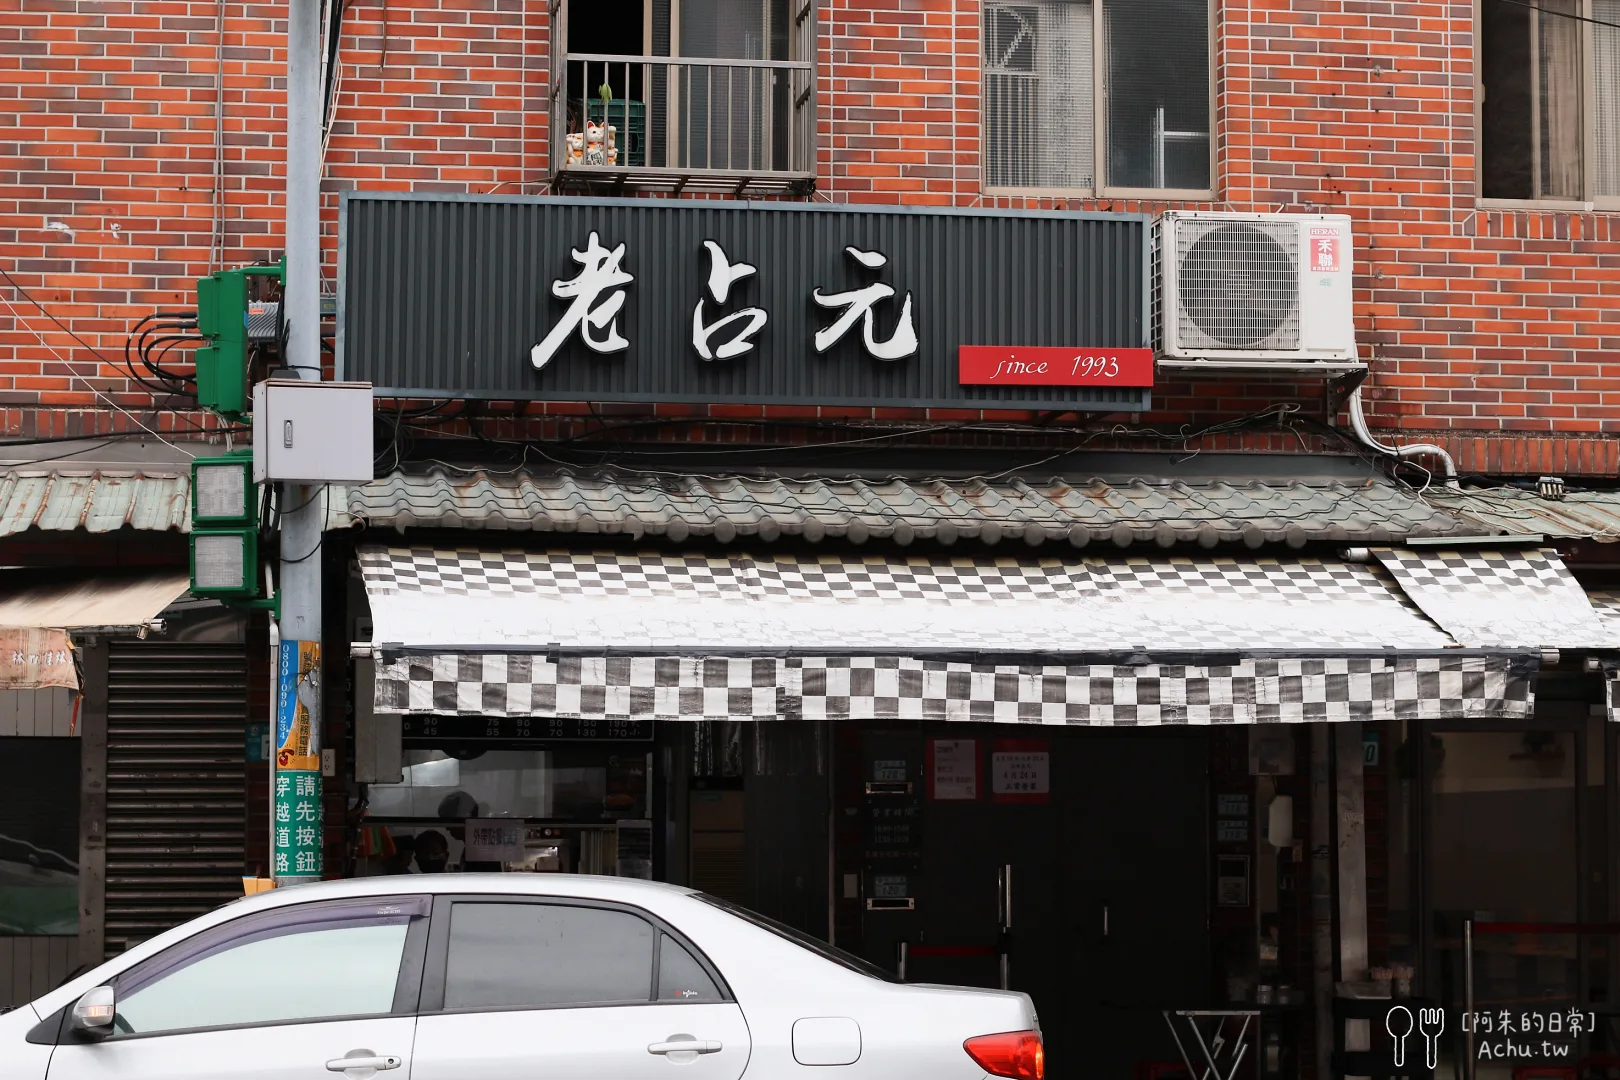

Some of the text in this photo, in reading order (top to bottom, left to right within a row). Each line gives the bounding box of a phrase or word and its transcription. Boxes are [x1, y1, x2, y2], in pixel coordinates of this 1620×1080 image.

[1310, 228, 1339, 236] HERAN
[1317, 239, 1333, 267] 禾聯
[529, 230, 920, 370] 老占元
[989, 354, 1120, 379] since 1993
[279, 644, 290, 740] 0800-090-234
[423, 717, 438, 726] 90
[487, 718, 500, 726] 75
[516, 719, 531, 727] 90
[549, 719, 563, 727] 90
[423, 727, 437, 735] 45
[486, 728, 500, 736] 55
[516, 728, 531, 737] 70
[549, 728, 563, 737] 70
[276, 775, 290, 873] 穿越道路
[295, 775, 316, 873] 請先按鈕
